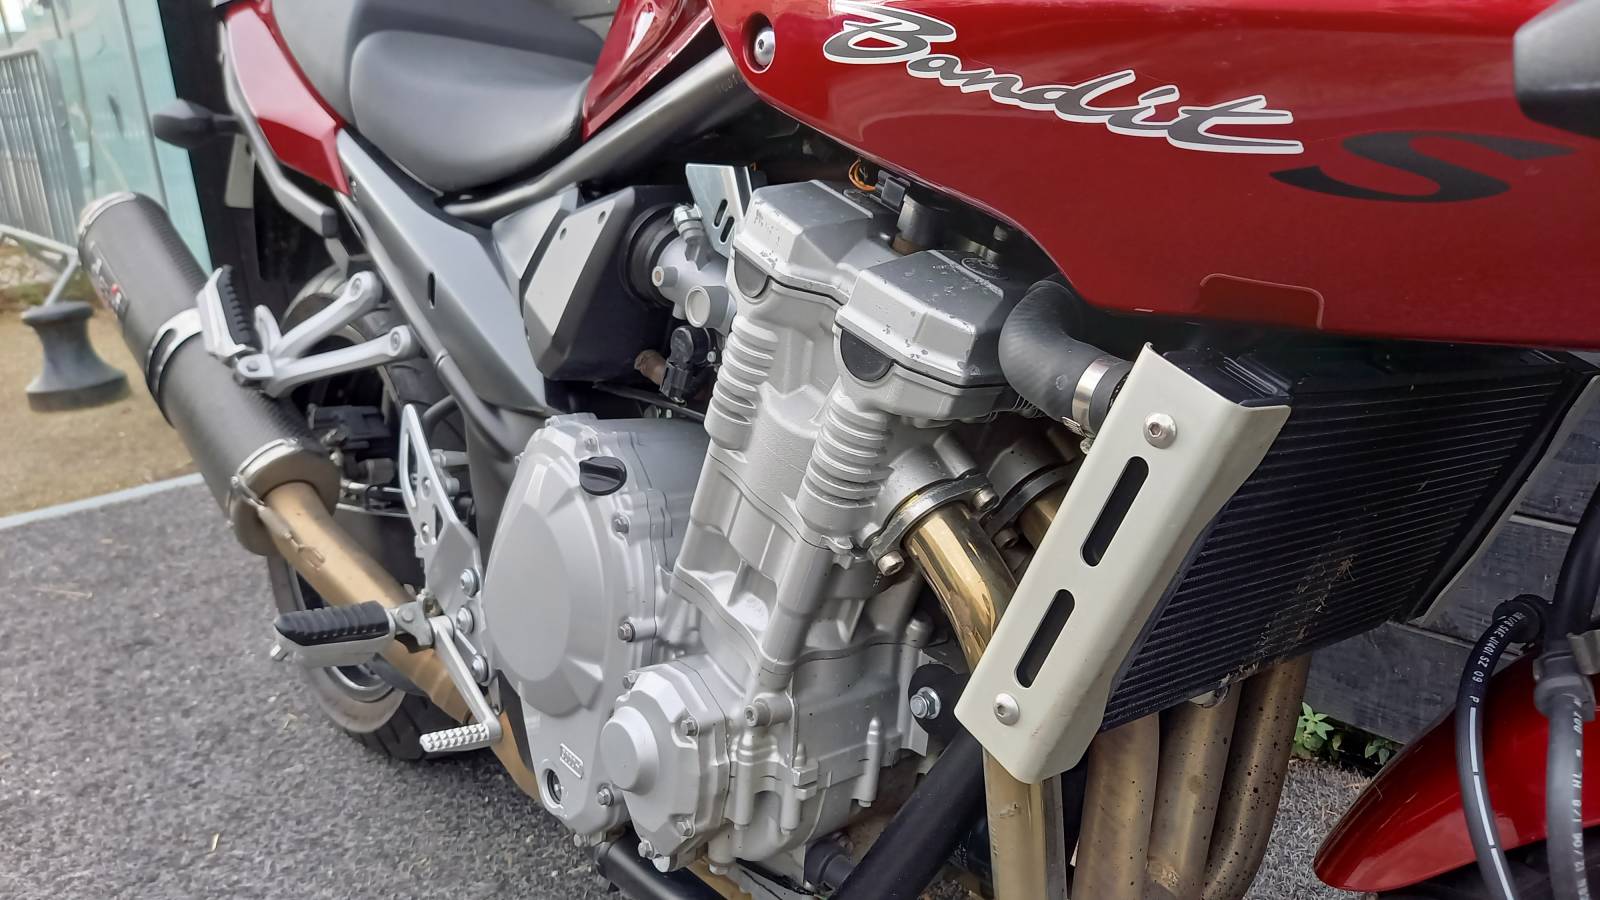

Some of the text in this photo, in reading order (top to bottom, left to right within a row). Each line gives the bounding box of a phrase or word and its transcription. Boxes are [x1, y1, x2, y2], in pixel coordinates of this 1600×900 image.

[823, 2, 1578, 203] Bandit S
[1494, 624, 1510, 638] SAE
